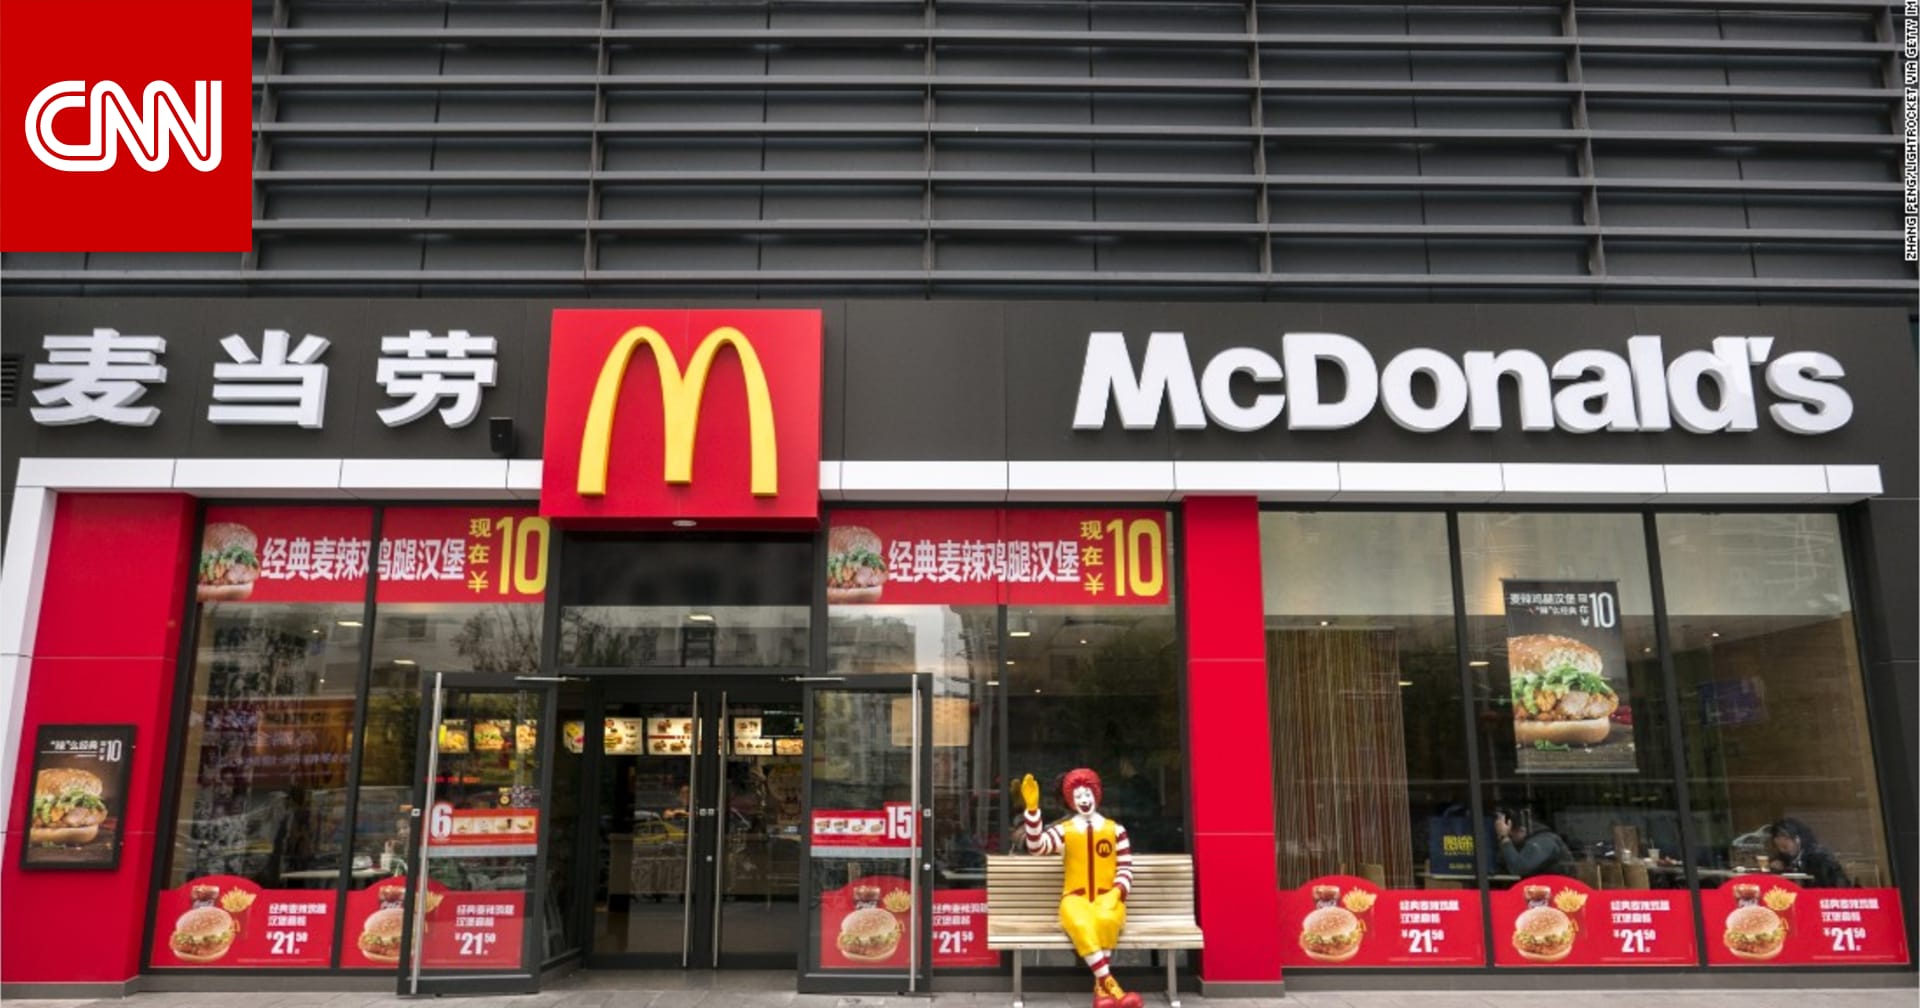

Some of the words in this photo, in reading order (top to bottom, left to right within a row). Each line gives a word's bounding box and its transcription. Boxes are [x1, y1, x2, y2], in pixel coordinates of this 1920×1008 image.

[30, 328, 498, 430] 麦当劳
[1072, 331, 1854, 434] McDonald's
[495, 516, 551, 595] 10
[888, 539, 1081, 583] 经典麦辣鸡腿汉堡
[1106, 518, 1164, 597] 10
[1589, 591, 1616, 628] 10
[106, 739, 122, 762] 10
[431, 803, 453, 839] 6
[886, 806, 914, 840] 15
